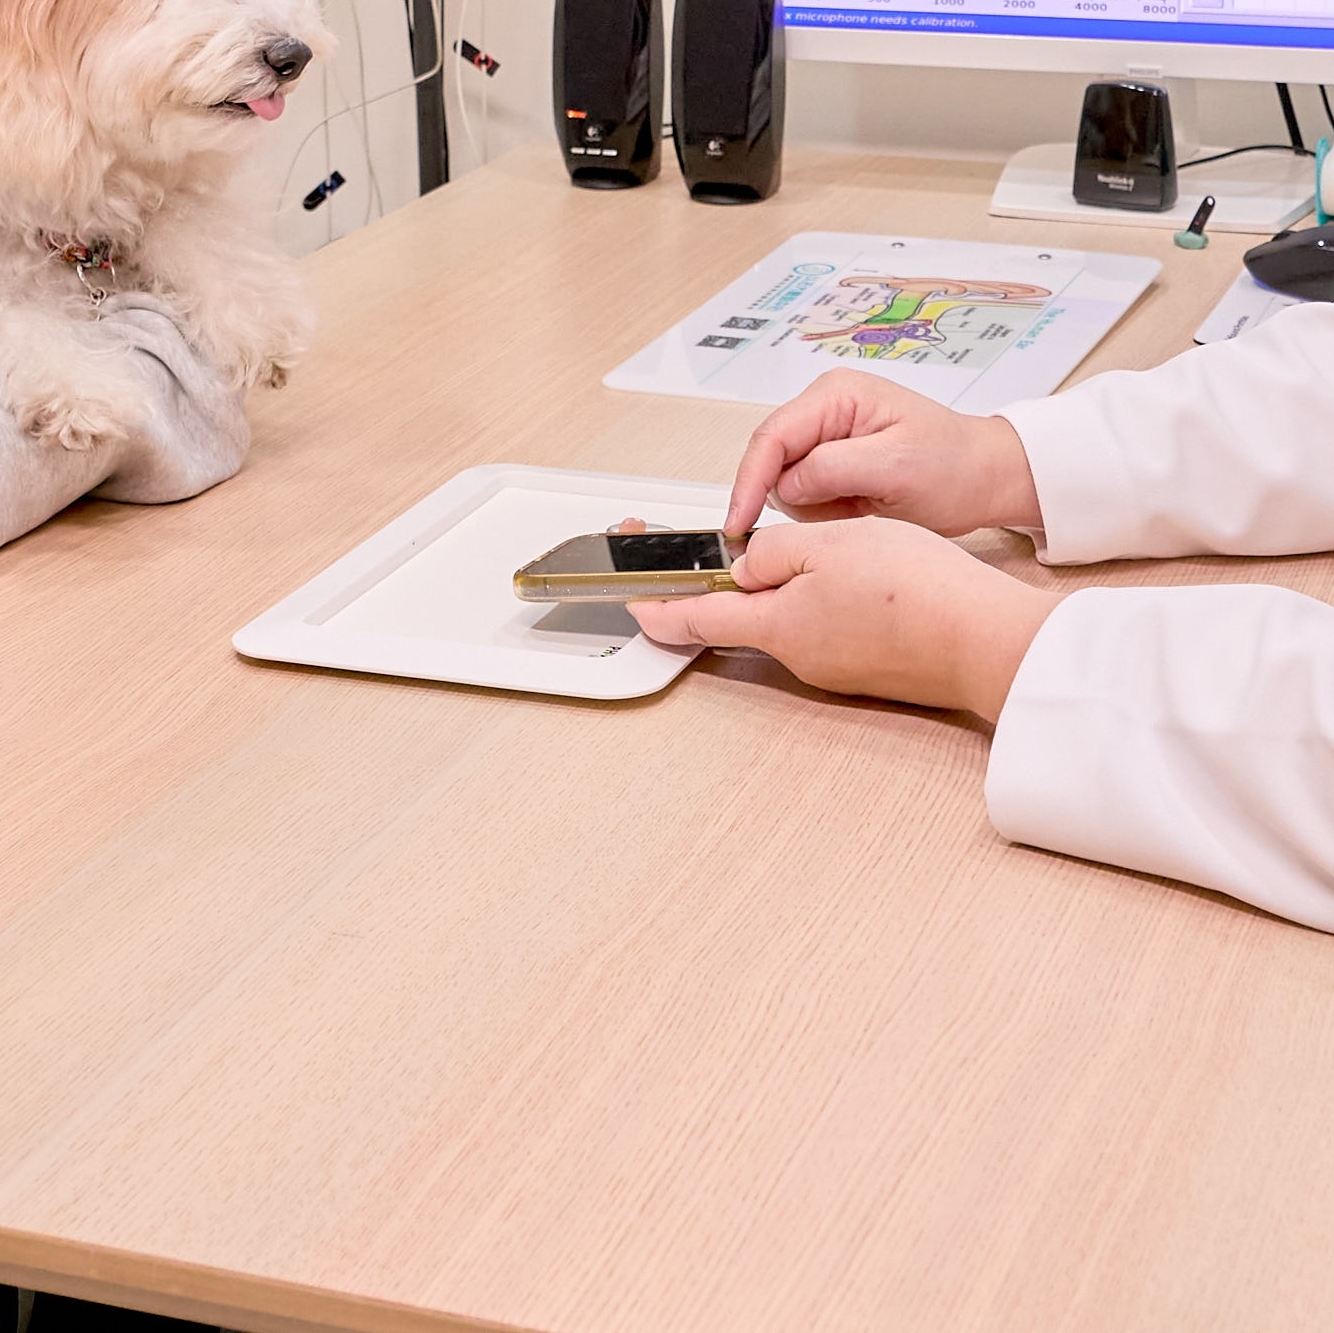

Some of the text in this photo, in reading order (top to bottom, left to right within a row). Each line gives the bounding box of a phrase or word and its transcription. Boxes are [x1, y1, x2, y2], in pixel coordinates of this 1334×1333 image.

[1003, 0, 1036, 9] 2000
[1074, 2, 1108, 12] 4000
[1143, 5, 1177, 15] 8000
[795, 12, 868, 25] microphone
[871, 15, 908, 26] needs
[910, 17, 979, 29] calibration.
